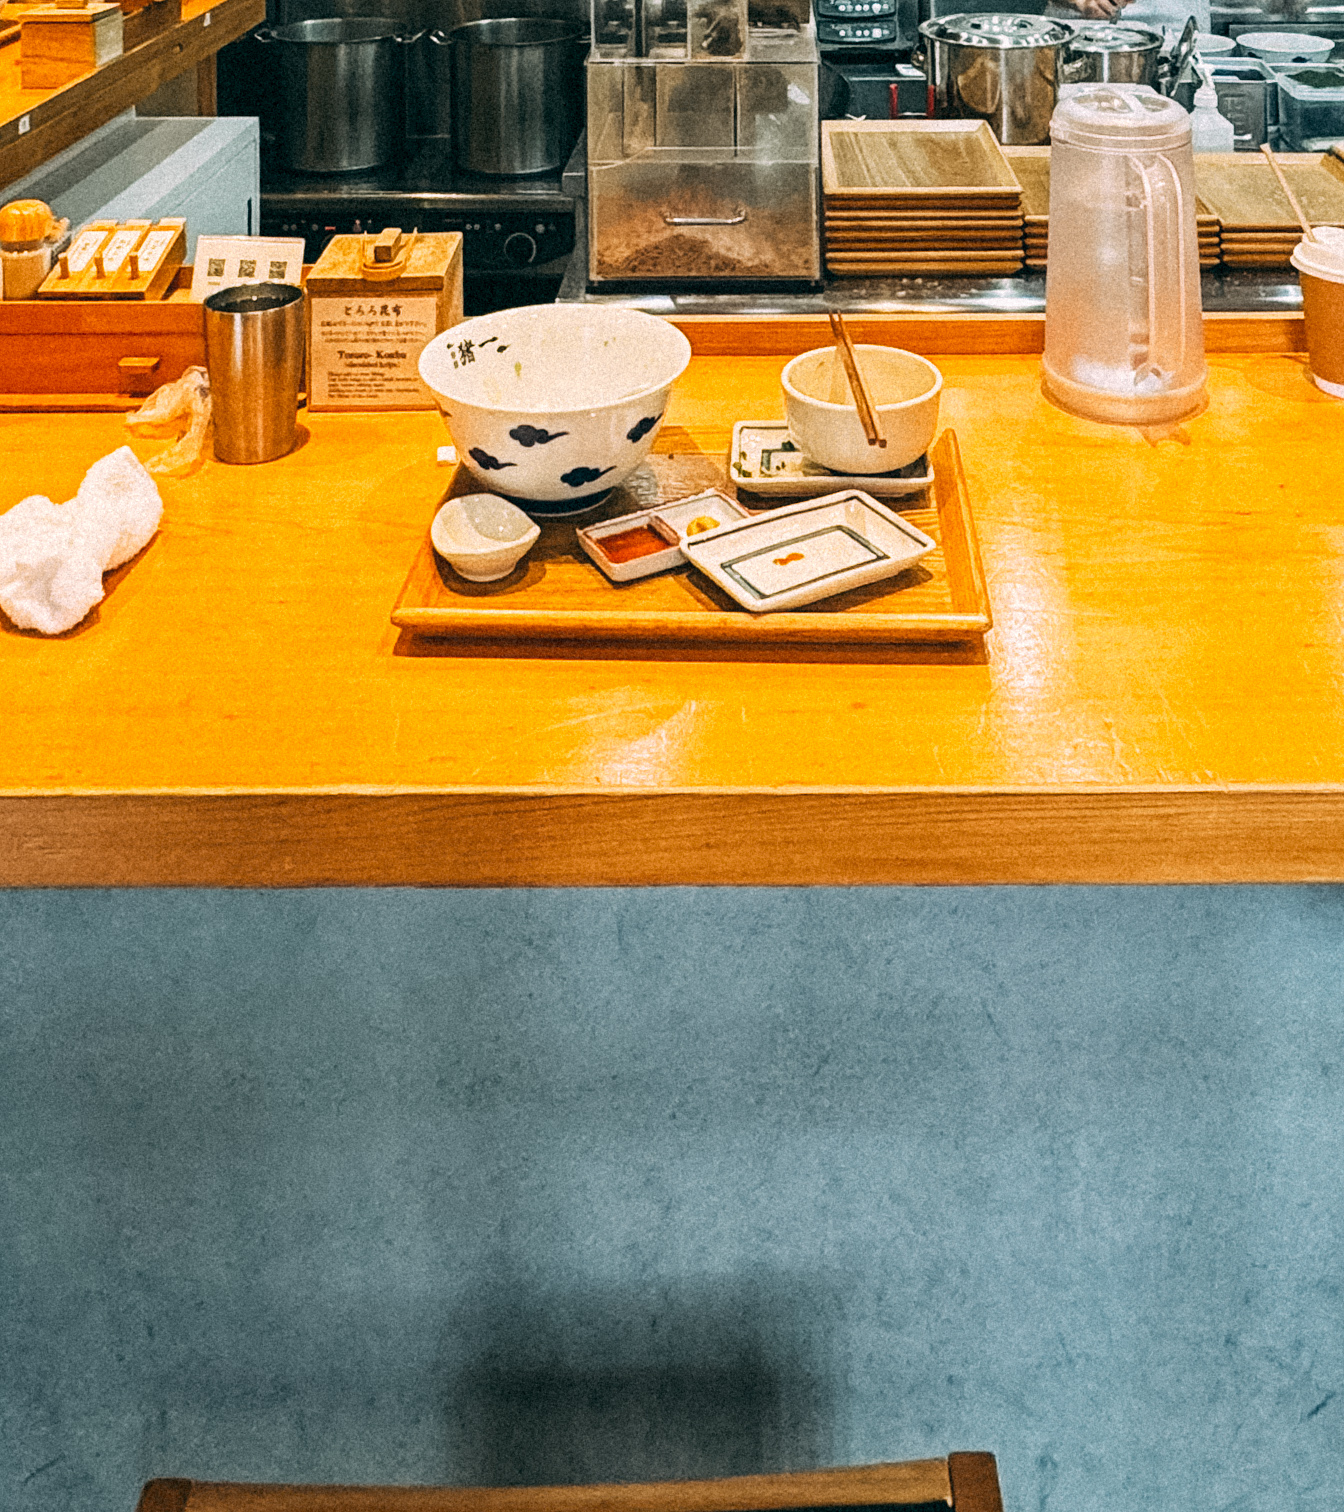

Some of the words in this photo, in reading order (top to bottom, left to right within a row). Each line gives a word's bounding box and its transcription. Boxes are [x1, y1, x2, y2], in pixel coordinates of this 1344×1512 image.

[344, 303, 404, 318] とろろ昆布
